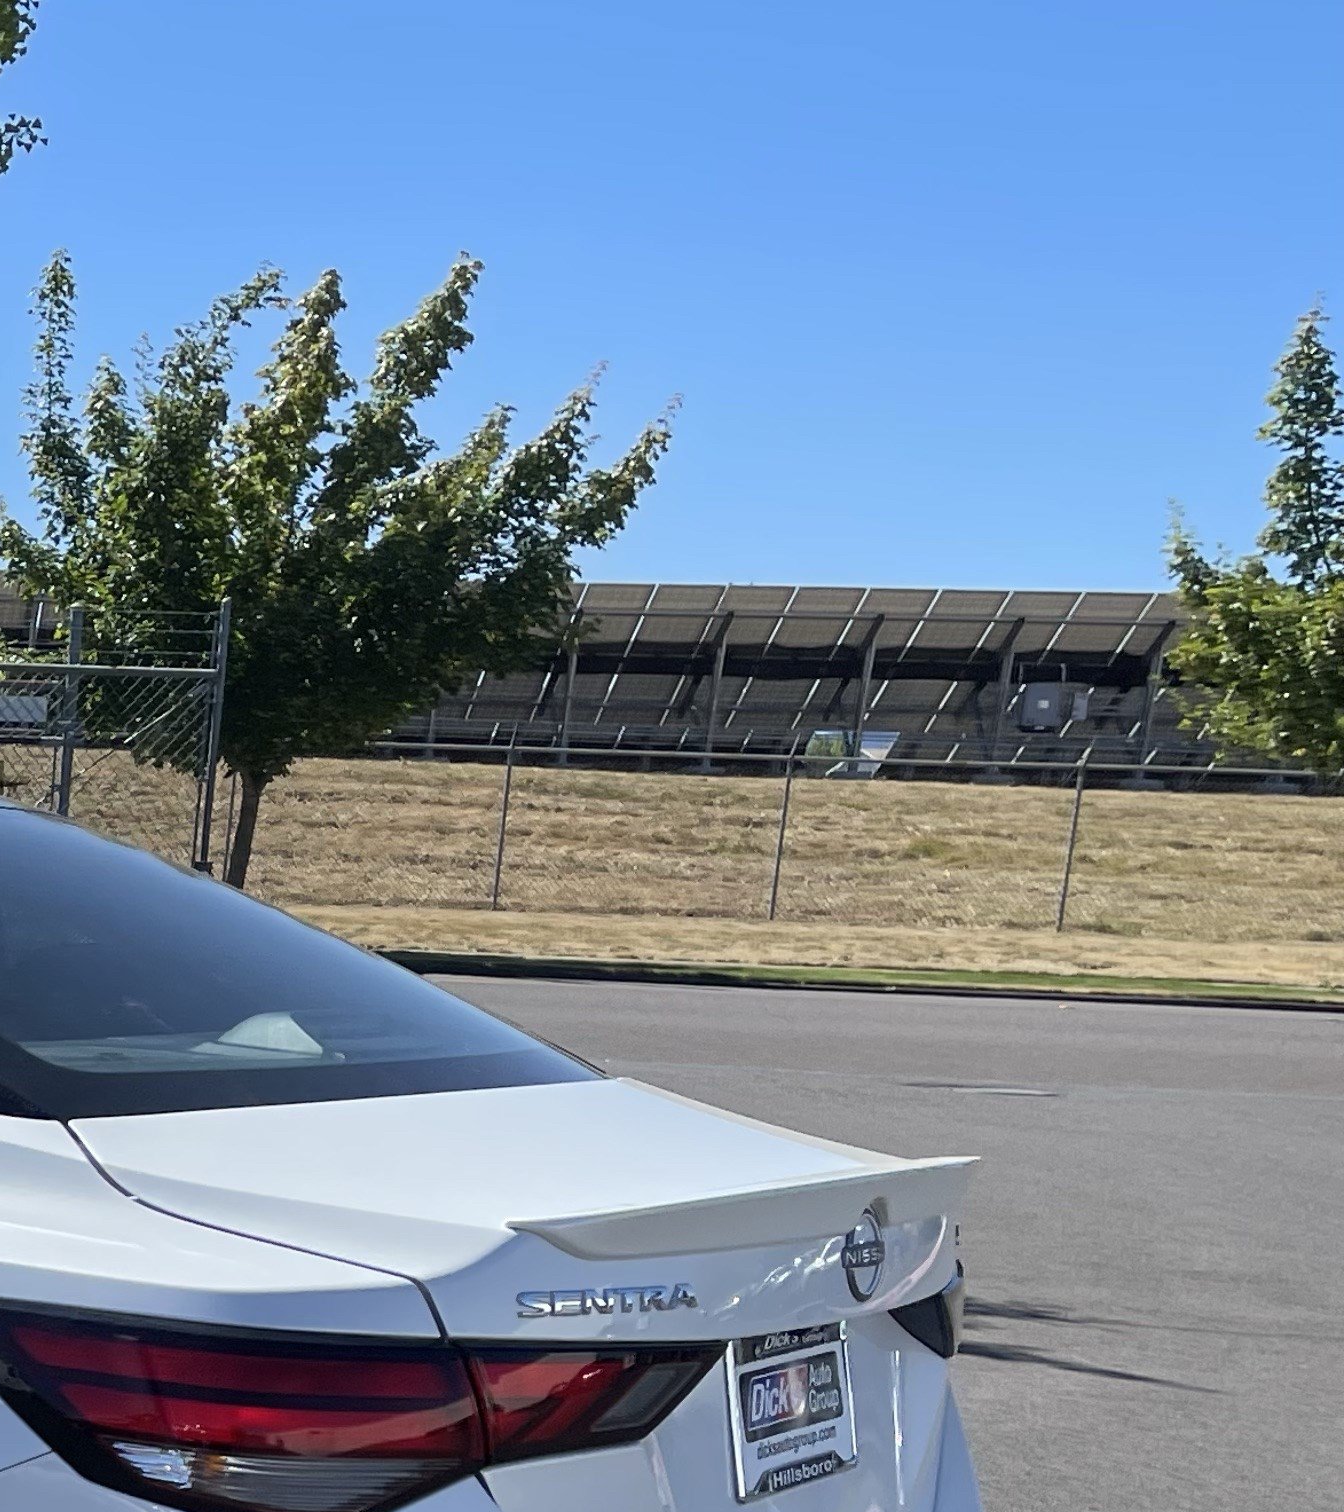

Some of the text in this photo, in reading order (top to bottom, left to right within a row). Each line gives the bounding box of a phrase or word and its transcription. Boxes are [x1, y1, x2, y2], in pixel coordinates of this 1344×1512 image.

[517, 1283, 698, 1318] SENTRA
[809, 1361, 833, 1387] Auto
[808, 1387, 840, 1414] Group
[773, 1459, 833, 1488] Hillsboro
